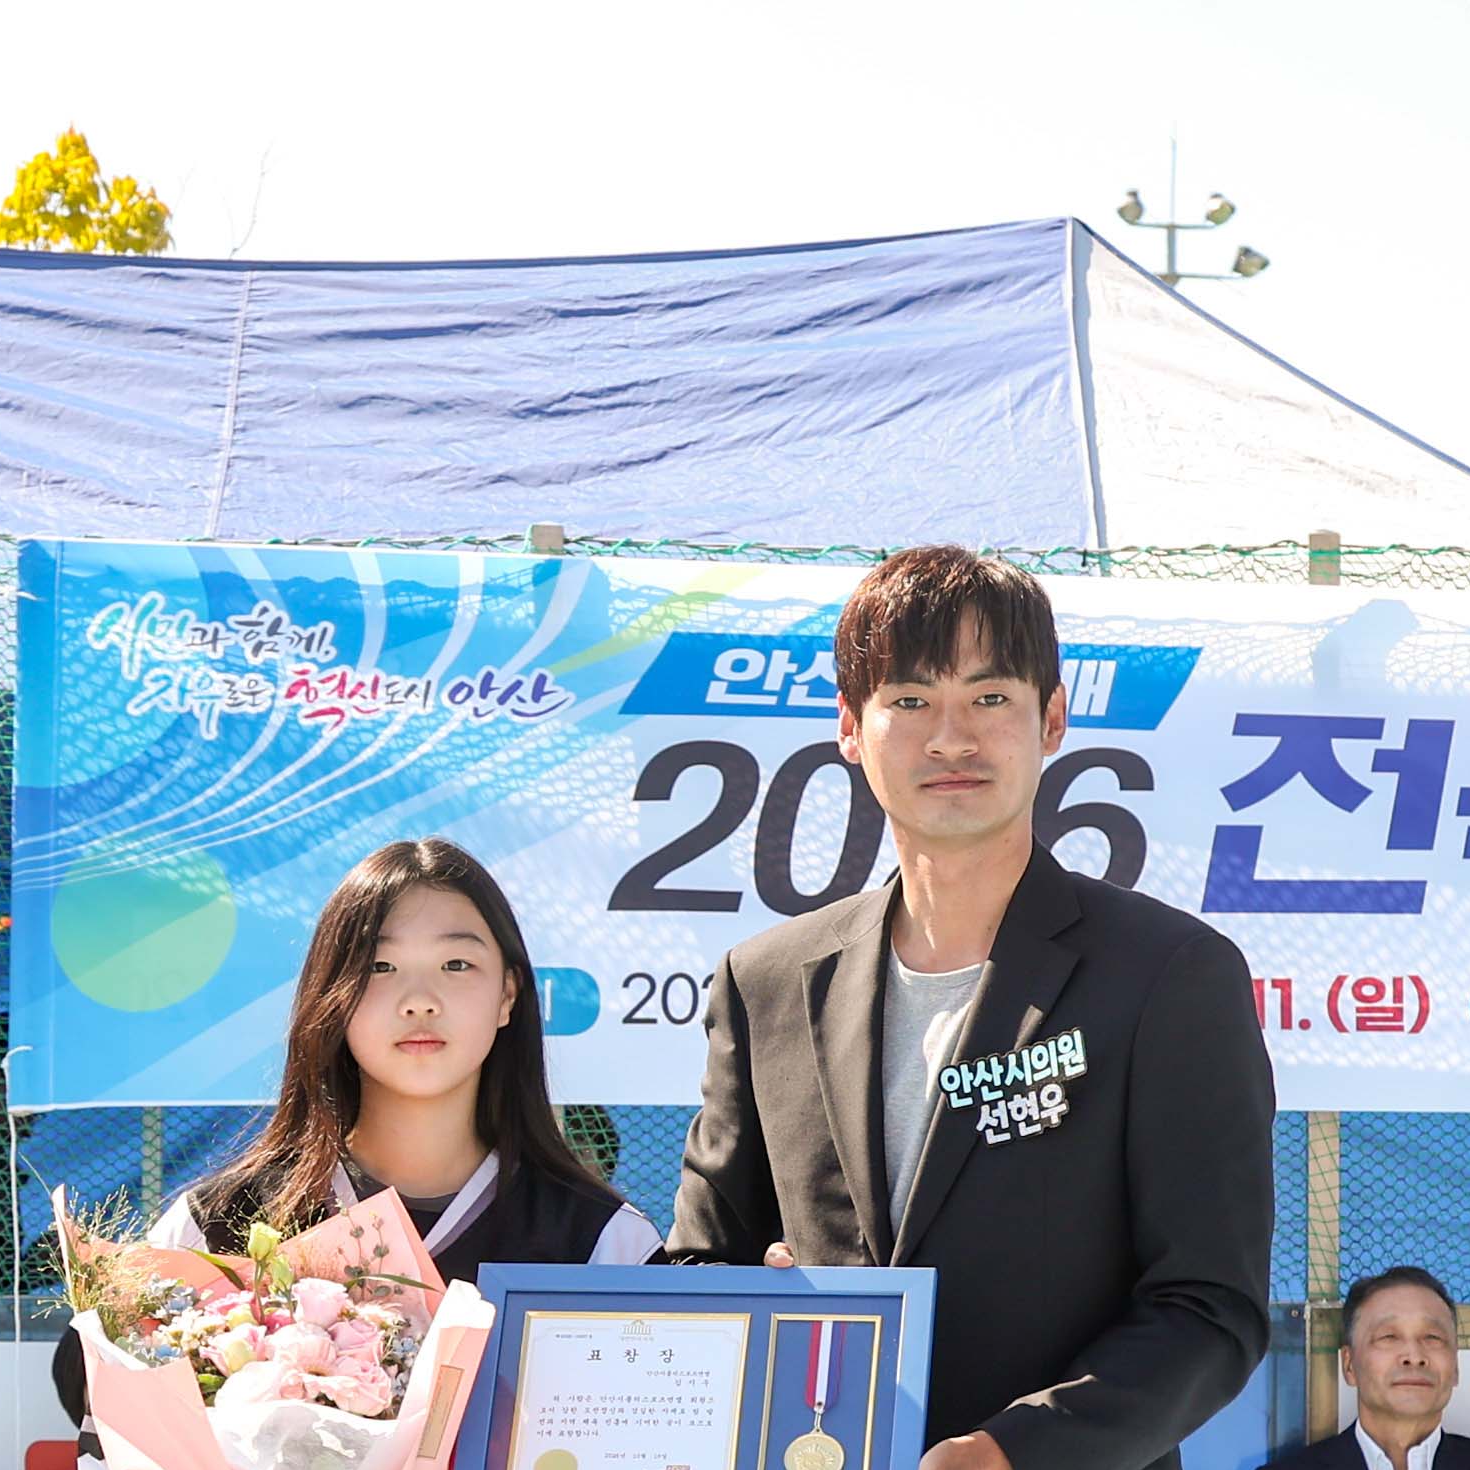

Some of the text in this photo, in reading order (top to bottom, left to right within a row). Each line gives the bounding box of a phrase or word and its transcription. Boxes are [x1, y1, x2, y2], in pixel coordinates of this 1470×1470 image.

[89, 595, 231, 677] 시민과
[133, 667, 570, 735] 자유로운 혁신도시 안산
[607, 740, 1156, 916] 206
[1326, 974, 1432, 1035] (일)
[940, 1029, 1086, 1109] 안산시의원
[975, 1083, 1067, 1145] 선현우
